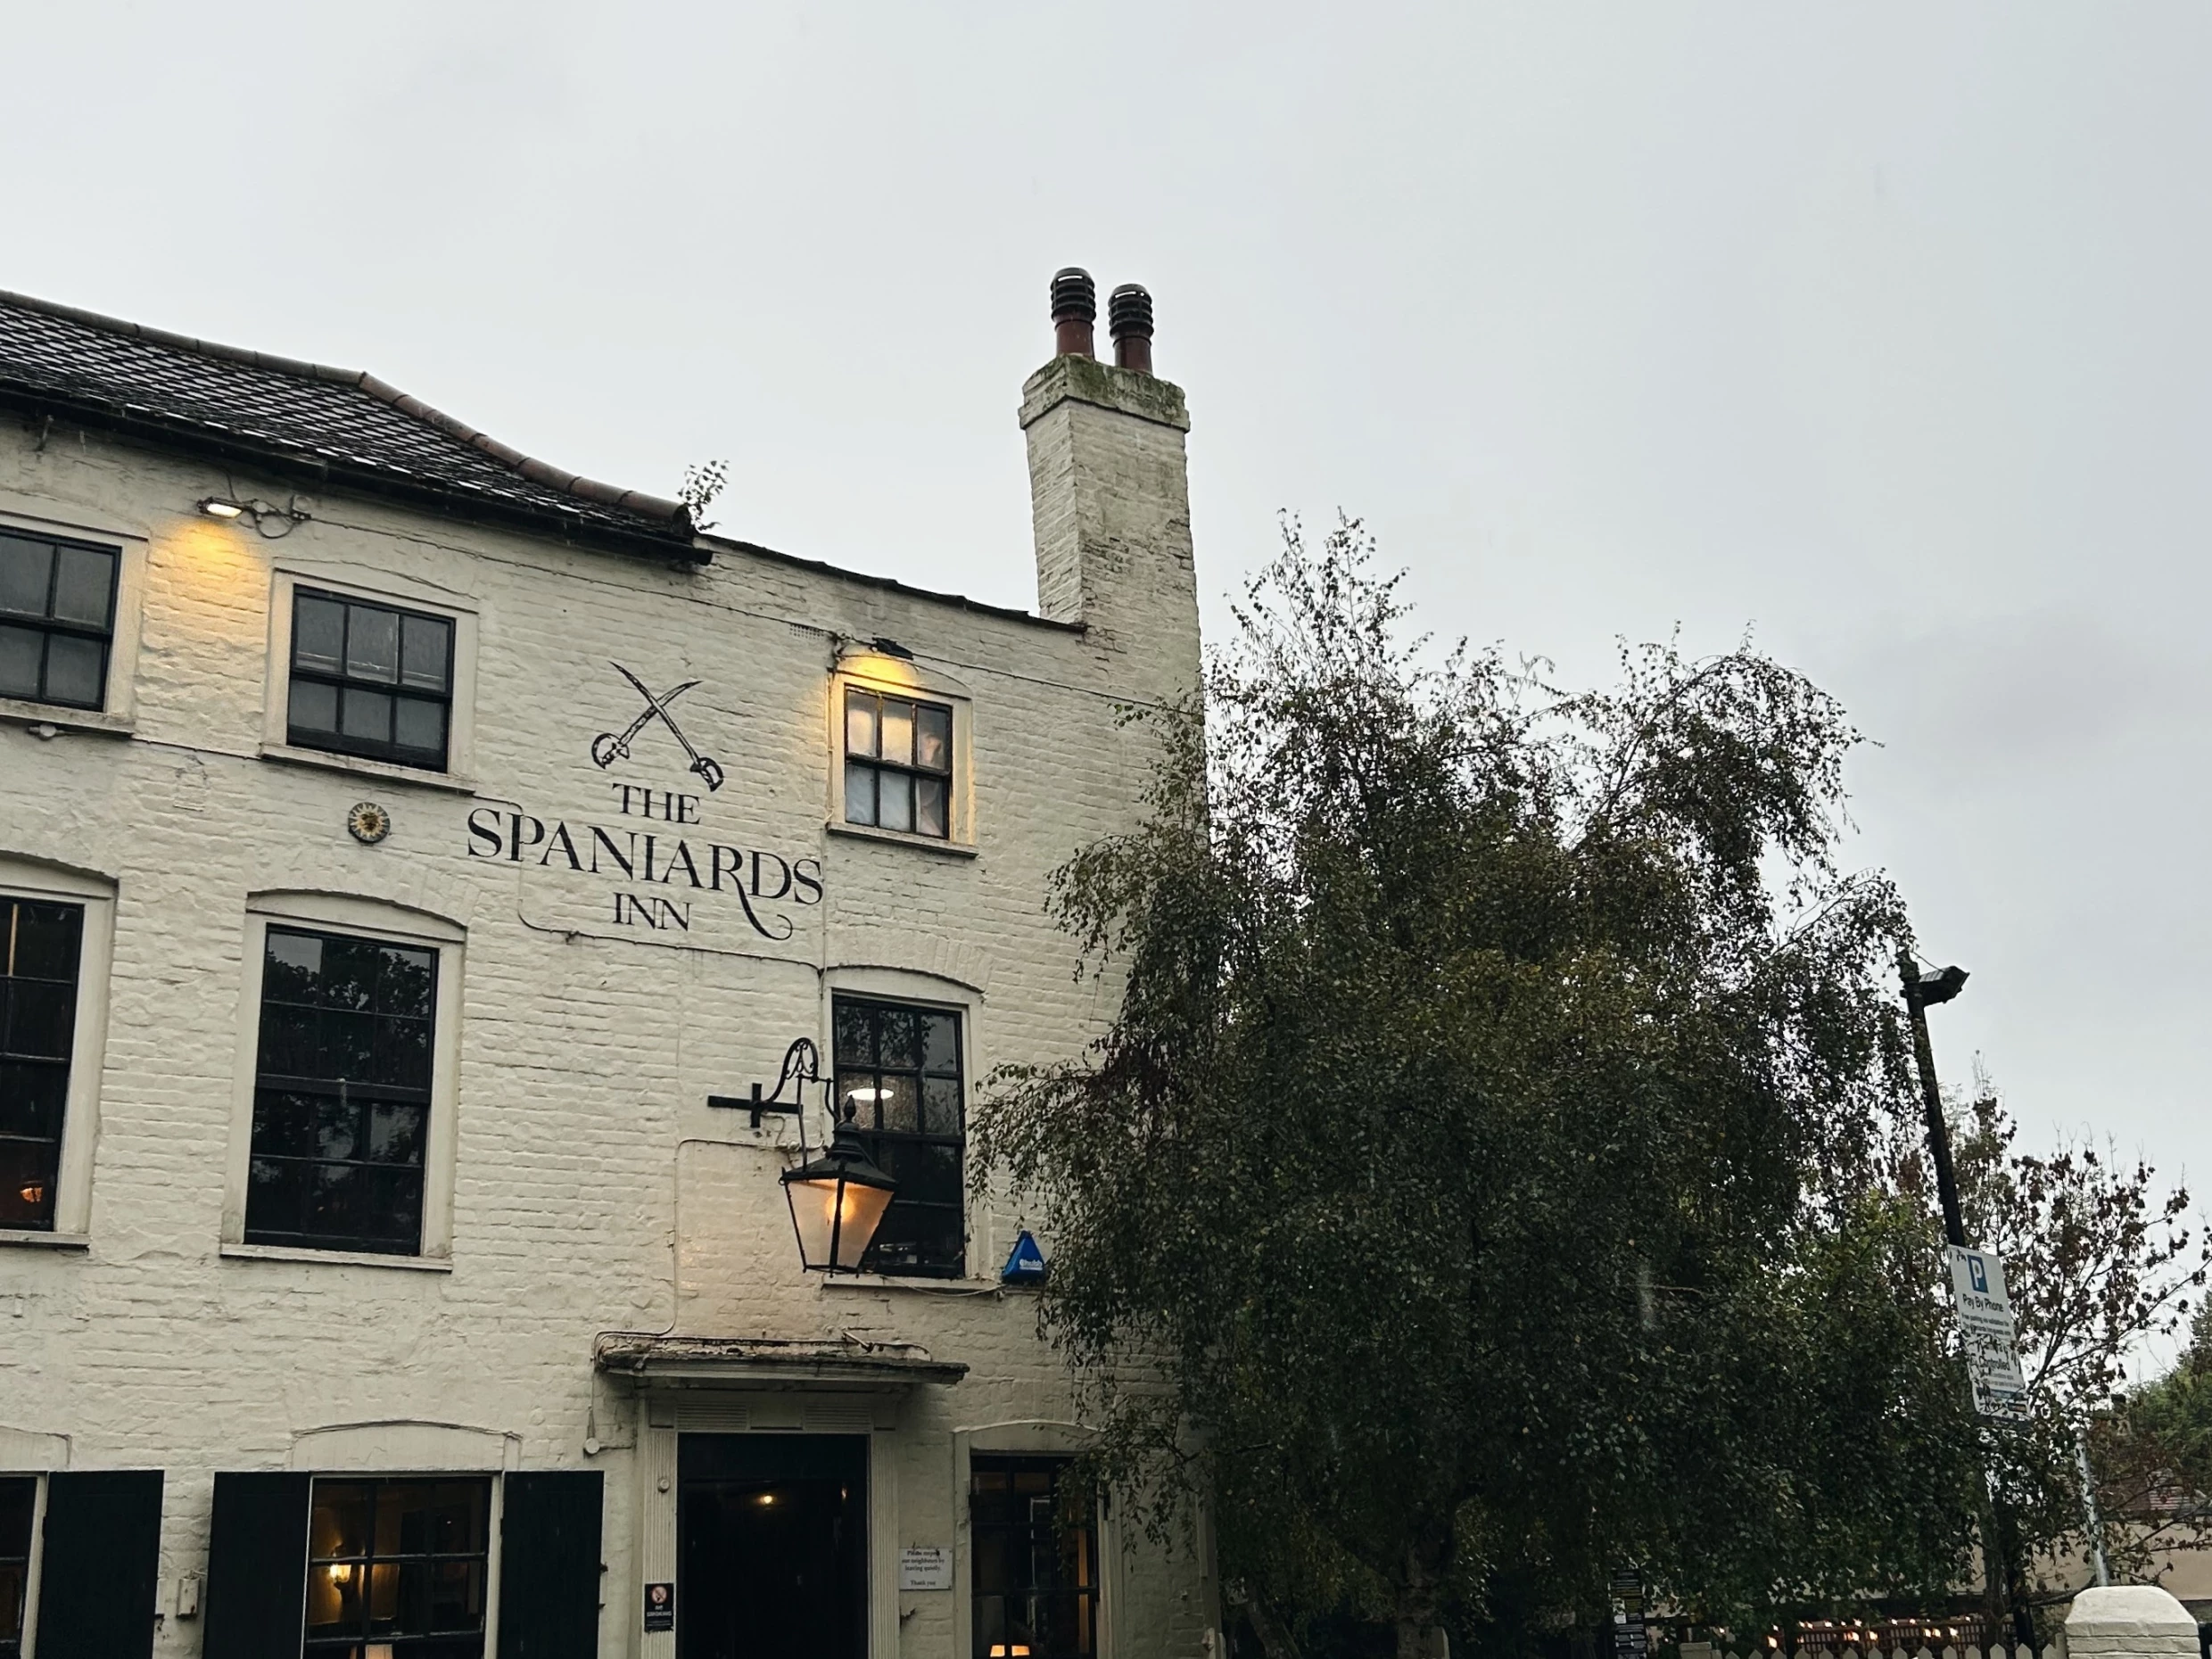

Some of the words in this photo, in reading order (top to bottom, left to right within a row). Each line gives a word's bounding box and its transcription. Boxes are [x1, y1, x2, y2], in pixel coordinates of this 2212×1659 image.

[612, 782, 701, 824] THE
[467, 808, 823, 941] SPANIARDS
[613, 892, 694, 931] INN
[1970, 1259, 1983, 1289] P
[1962, 1293, 1974, 1309] Pay
[1975, 1296, 1984, 1311] By
[1984, 1298, 2004, 1312] Phone
